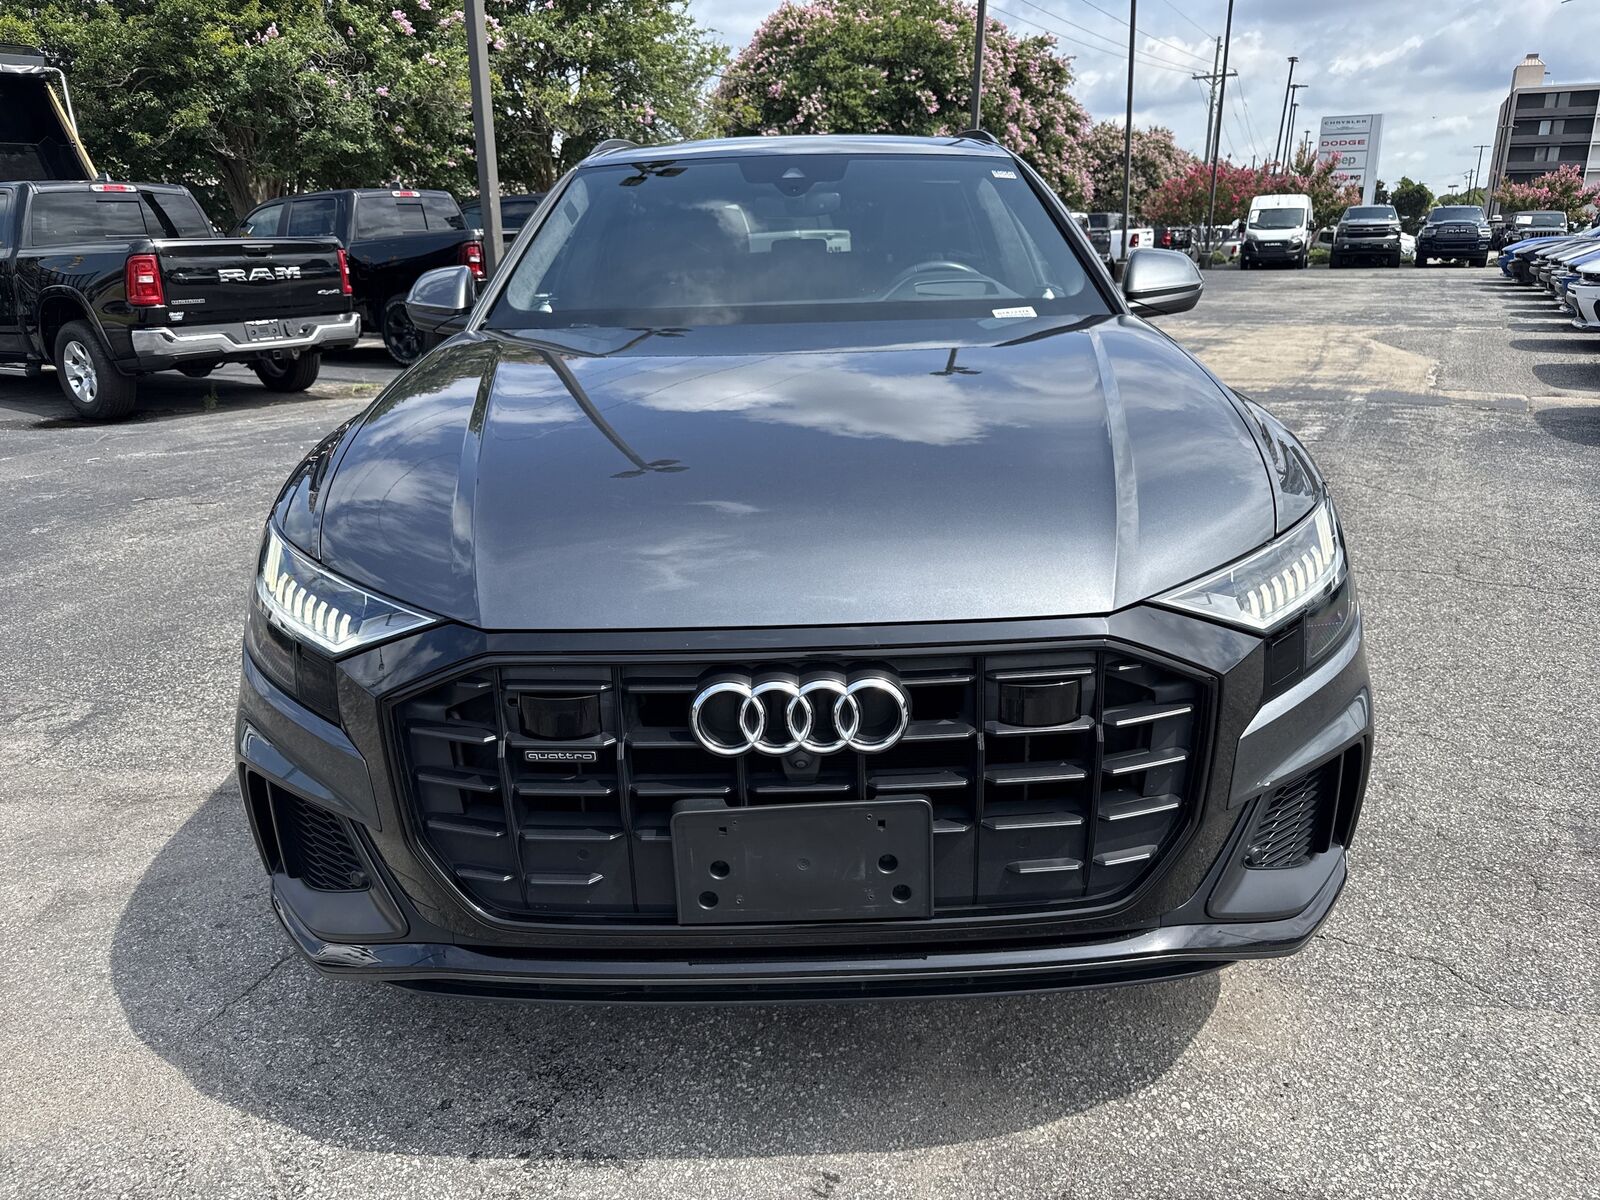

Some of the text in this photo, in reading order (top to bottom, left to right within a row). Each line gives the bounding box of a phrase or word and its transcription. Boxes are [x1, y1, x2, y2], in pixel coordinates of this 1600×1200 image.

[1321, 139, 1366, 147] DODGE
[217, 266, 301, 283] RAM
[528, 752, 593, 760] quattro
